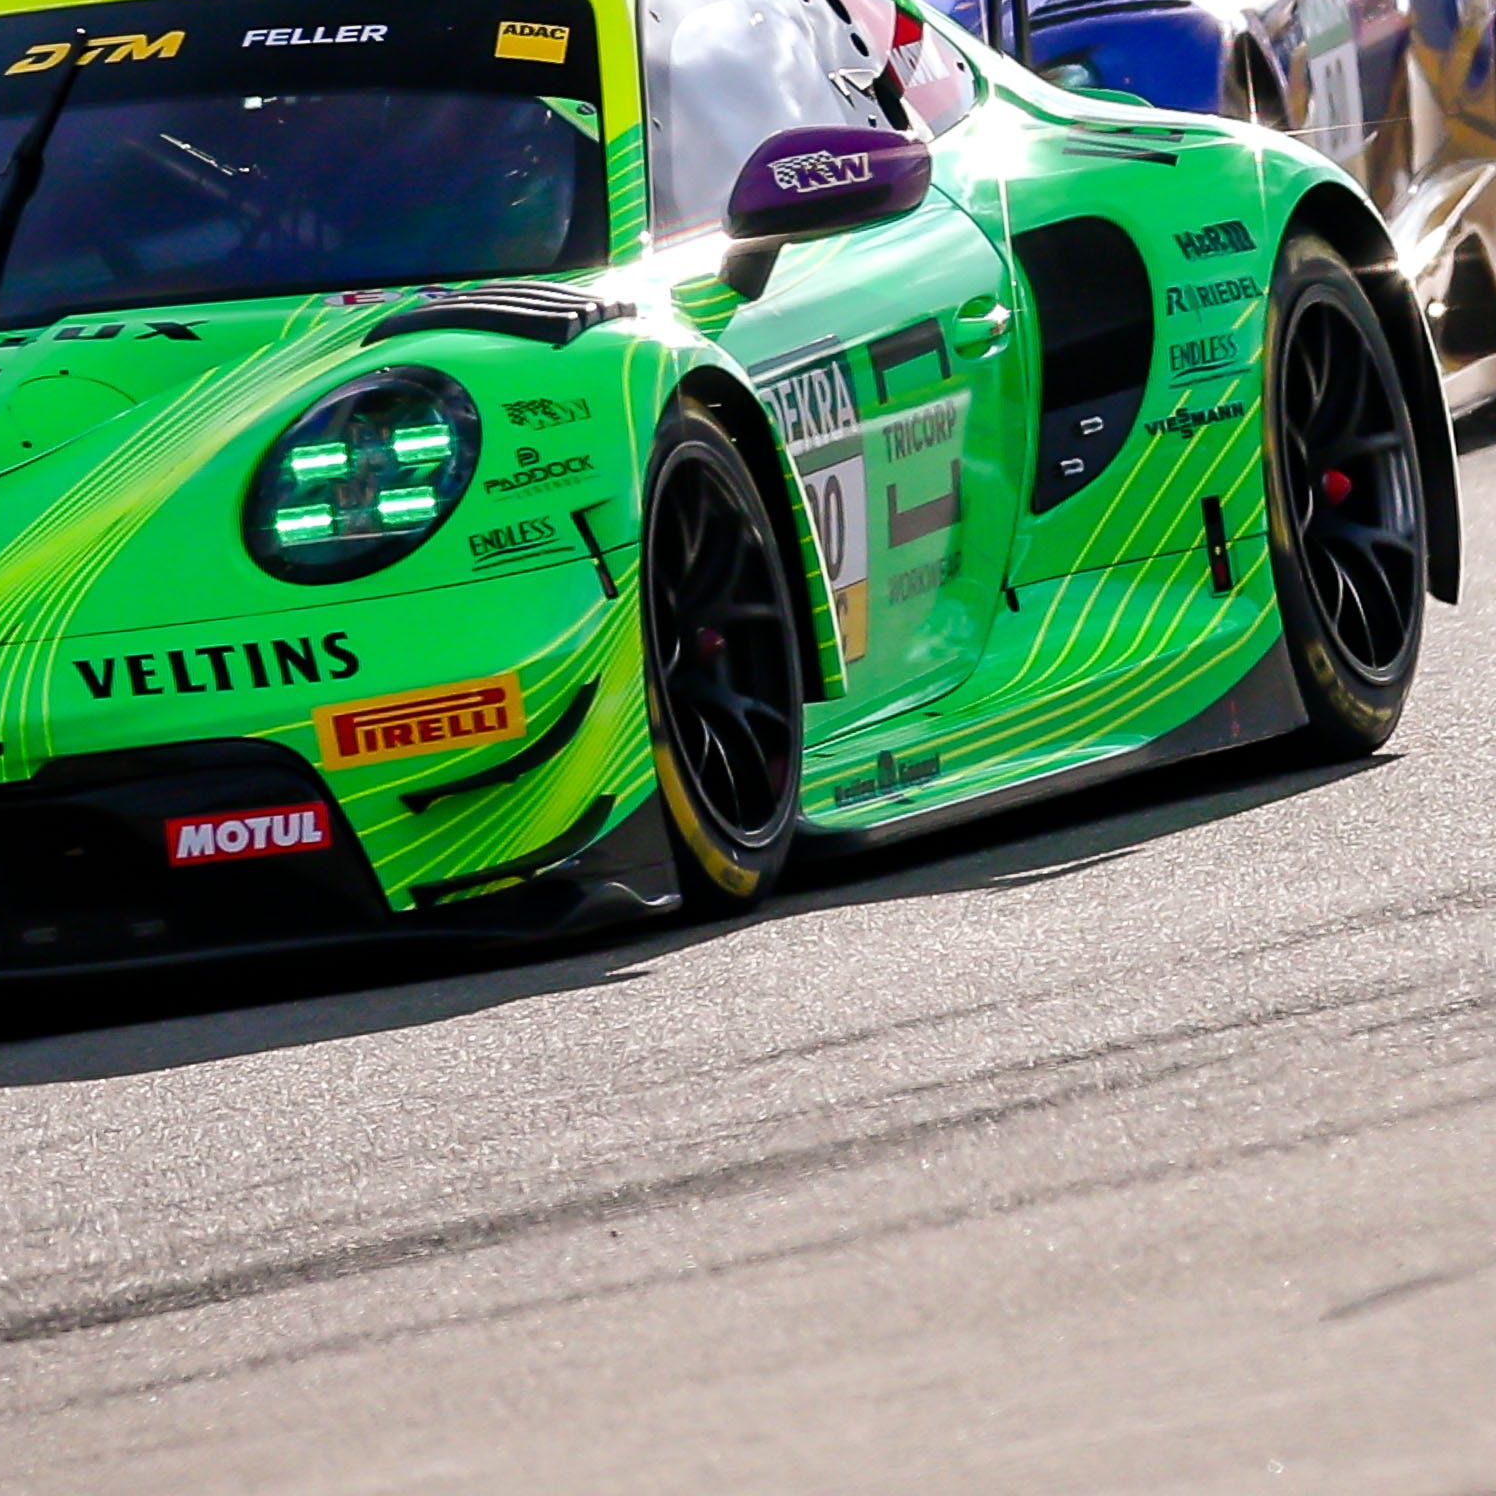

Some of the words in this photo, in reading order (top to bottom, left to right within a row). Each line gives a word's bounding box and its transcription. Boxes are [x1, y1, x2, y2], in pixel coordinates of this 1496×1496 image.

[242, 24, 388, 49] FELLER
[503, 23, 566, 40] ADAC
[4, 30, 185, 76] DTM
[787, 152, 873, 193] KW
[1197, 275, 1264, 309] RIEDEL
[1169, 332, 1239, 372] ENDLESS
[883, 398, 956, 464] TRICORP
[483, 454, 595, 495] PADDOCK
[468, 516, 556, 556] ENDLESS
[72, 631, 360, 699] VELTINS
[332, 686, 510, 758] PIRELLI
[175, 809, 324, 859] MOTUL
